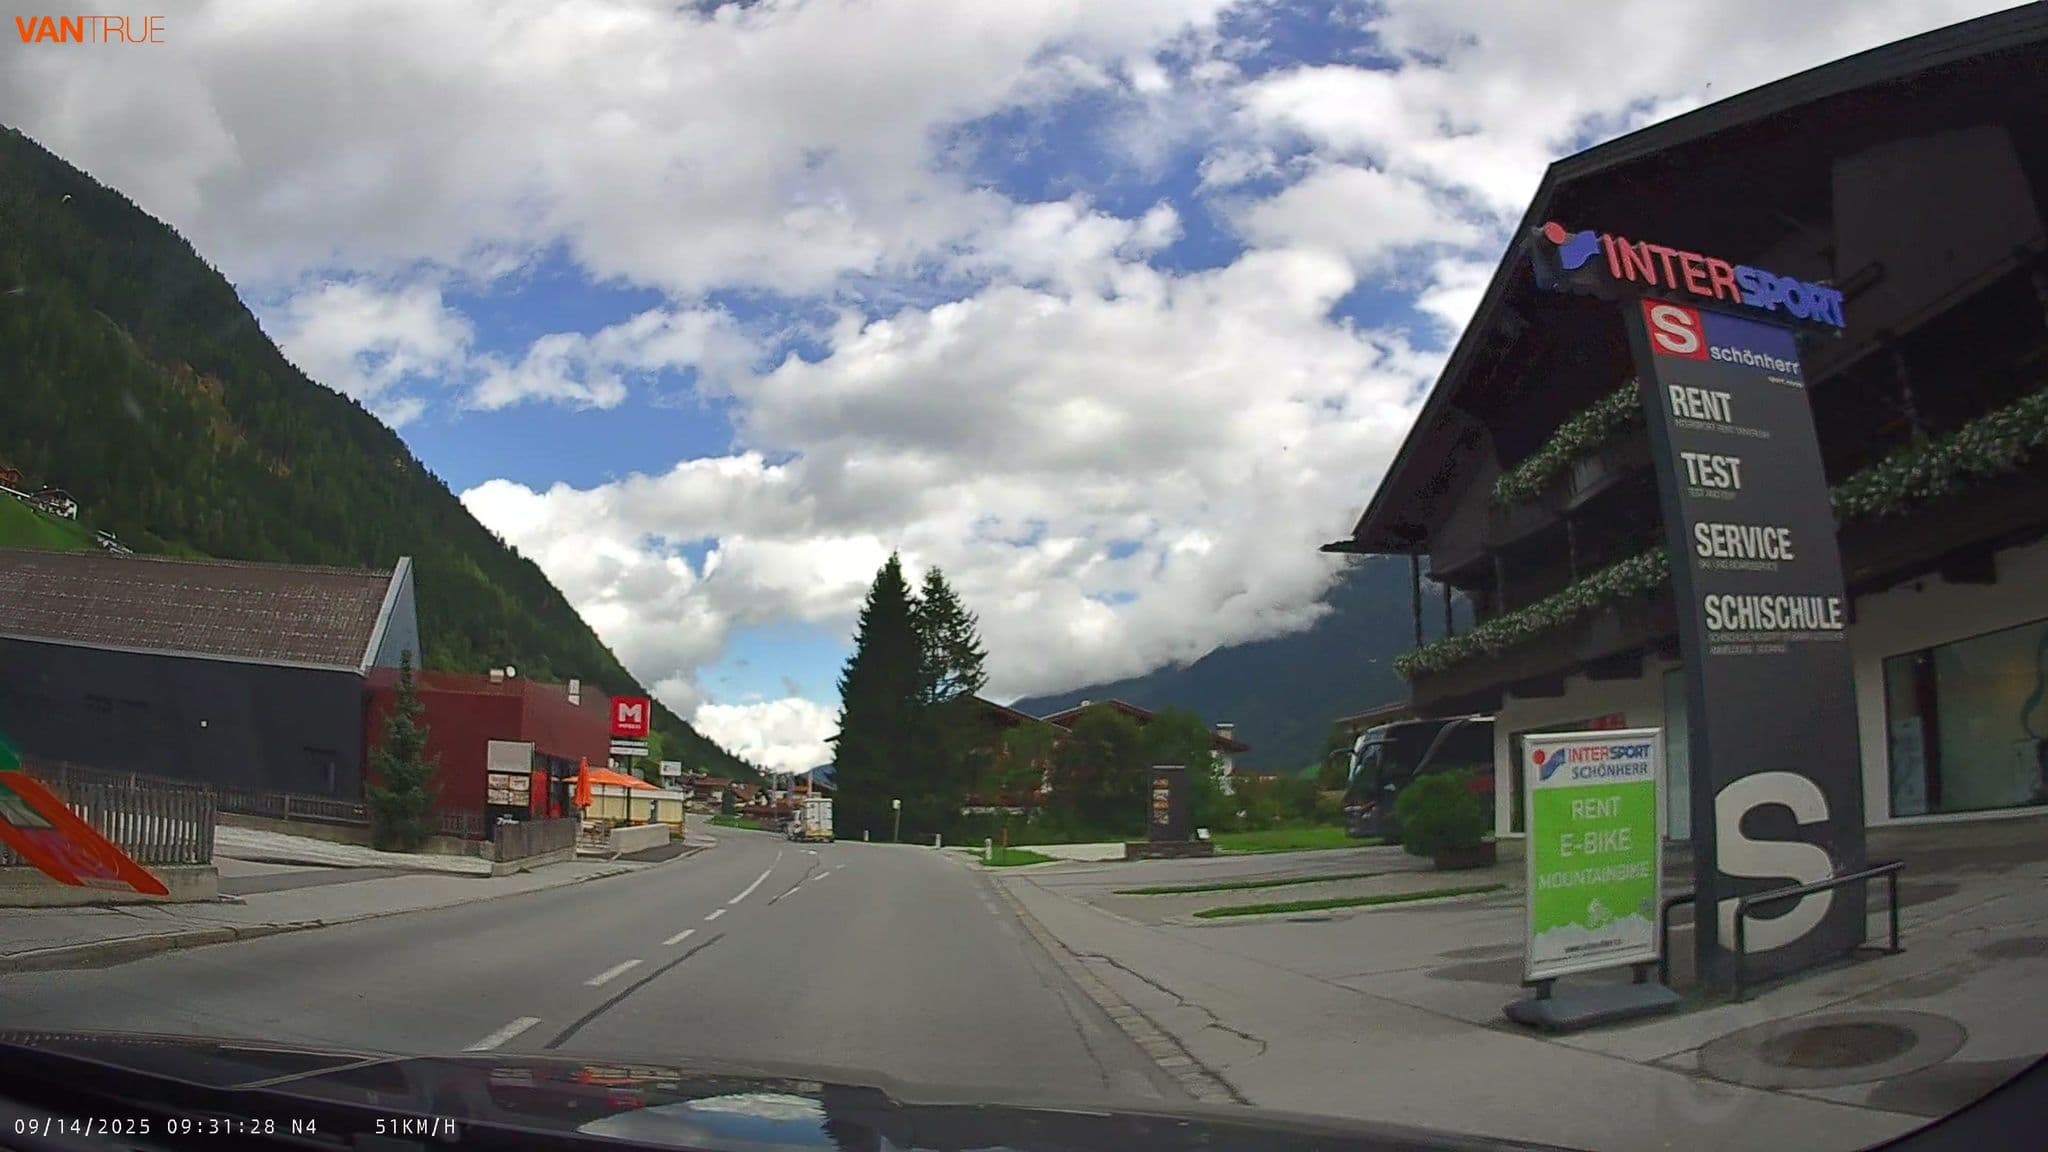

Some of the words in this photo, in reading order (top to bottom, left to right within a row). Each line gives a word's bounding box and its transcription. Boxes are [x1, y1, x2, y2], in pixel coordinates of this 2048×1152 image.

[1602, 233, 1846, 328] INTERSPORT
[1650, 304, 1701, 354] S
[1710, 344, 1801, 375] schönherr
[1668, 384, 1732, 423] RENT
[1680, 452, 1741, 490] TEST
[1694, 522, 1795, 561] SERVICE
[1704, 594, 1844, 631] SCHISCHULE
[618, 703, 642, 722] M
[1568, 744, 1651, 763] INTERSPORT
[1572, 761, 1648, 780] SCHÖNHERR
[1571, 797, 1621, 819] RENT
[1560, 829, 1632, 857] E-BIKE
[1539, 861, 1649, 890] MOUNTAINBIKE
[1715, 771, 1833, 953] S
